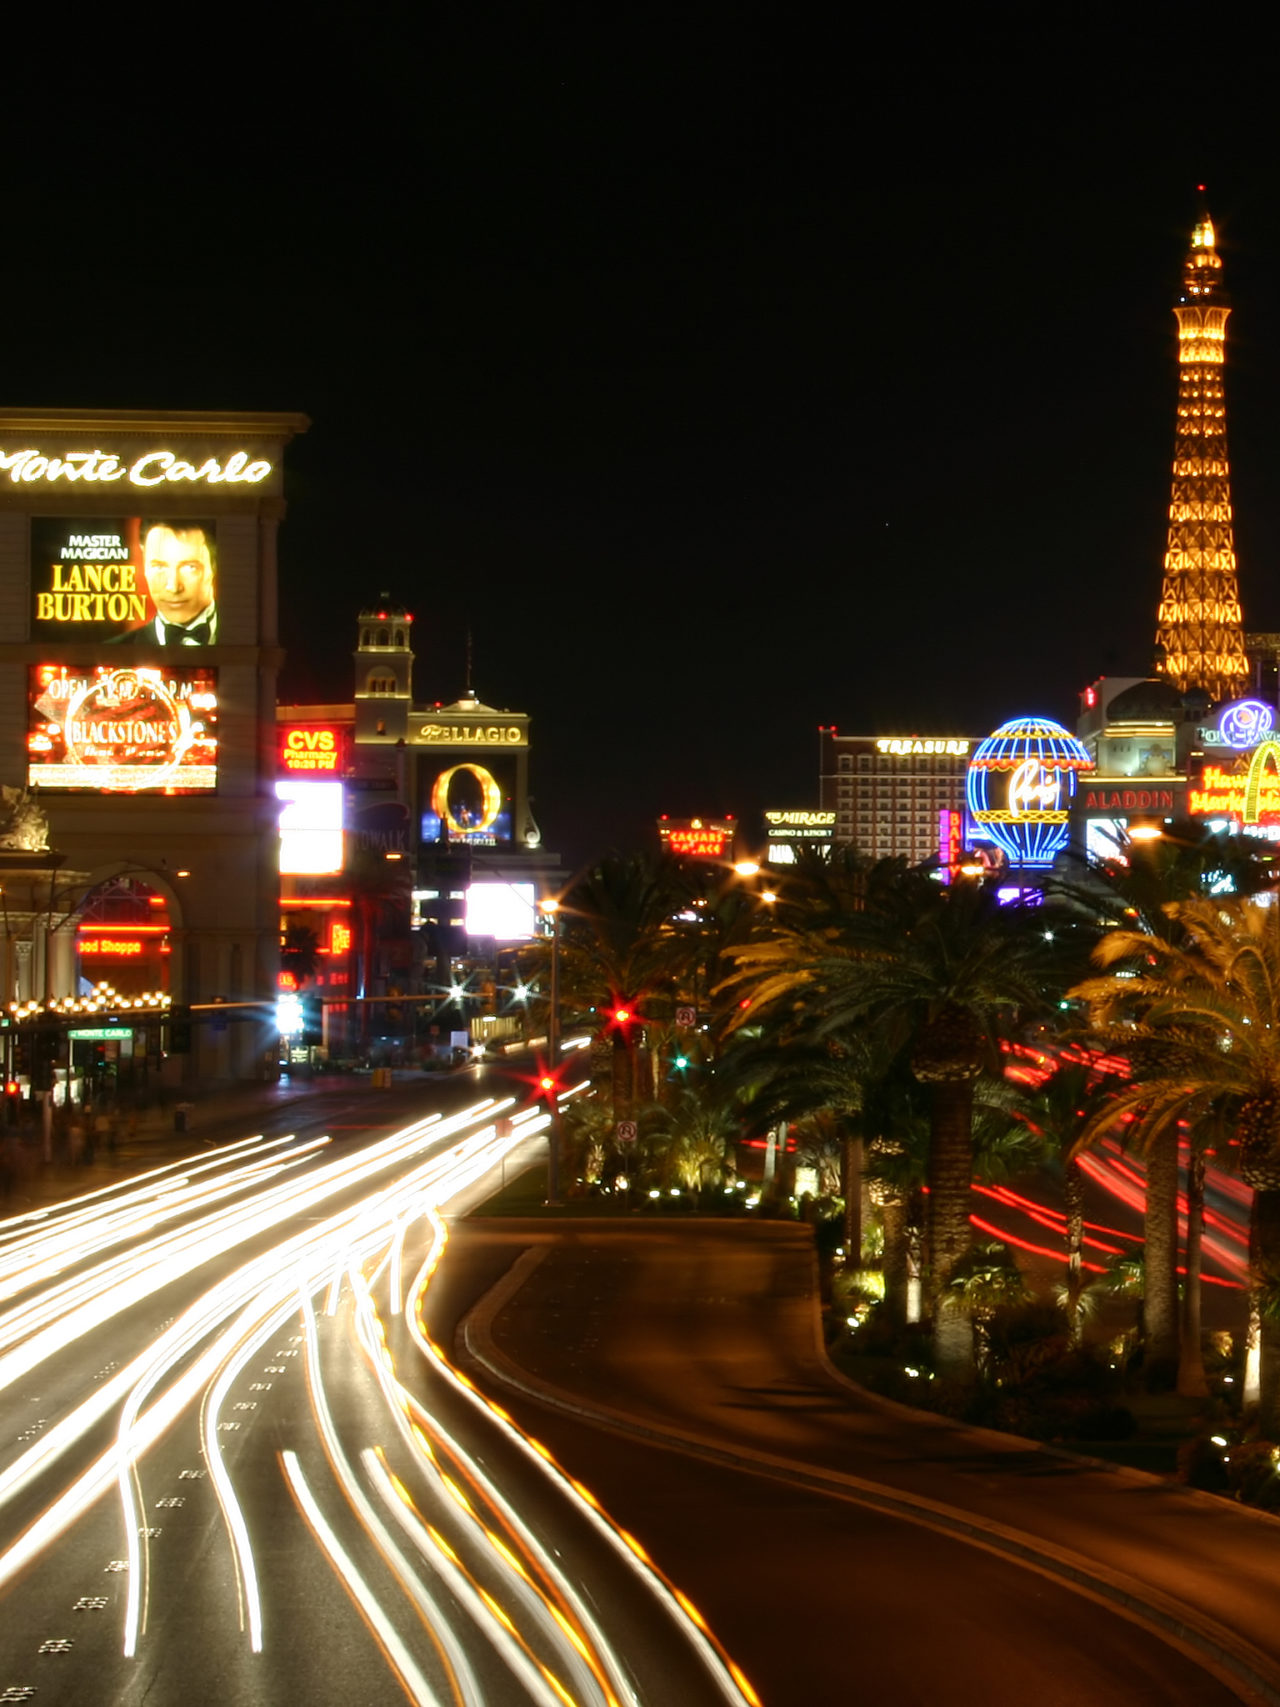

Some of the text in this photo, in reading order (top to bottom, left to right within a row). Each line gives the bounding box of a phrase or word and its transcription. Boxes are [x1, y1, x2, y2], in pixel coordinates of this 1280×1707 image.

[0, 449, 271, 486] Monte Carlo
[69, 535, 121, 547] MASTER
[61, 547, 128, 559] MAGICIAN
[52, 565, 136, 592] LANCE
[37, 593, 146, 621] BURTON
[50, 679, 88, 698] OPEN
[72, 721, 177, 744] BLACKSTONE'S
[288, 731, 334, 750] CVS
[419, 725, 521, 742] BELLAGIO
[284, 749, 337, 761] Pharmacy
[877, 739, 969, 755] TREASURE
[1009, 758, 1060, 818] Paris
[431, 763, 501, 833] O
[1086, 791, 1173, 809] ALADDIN
[774, 812, 836, 826] MIRAGE
[669, 832, 723, 843] CAESARS
[673, 843, 721, 855] PAACE
[101, 940, 141, 955] Shoppe
[78, 1028, 132, 1037] MONTE CARLO
